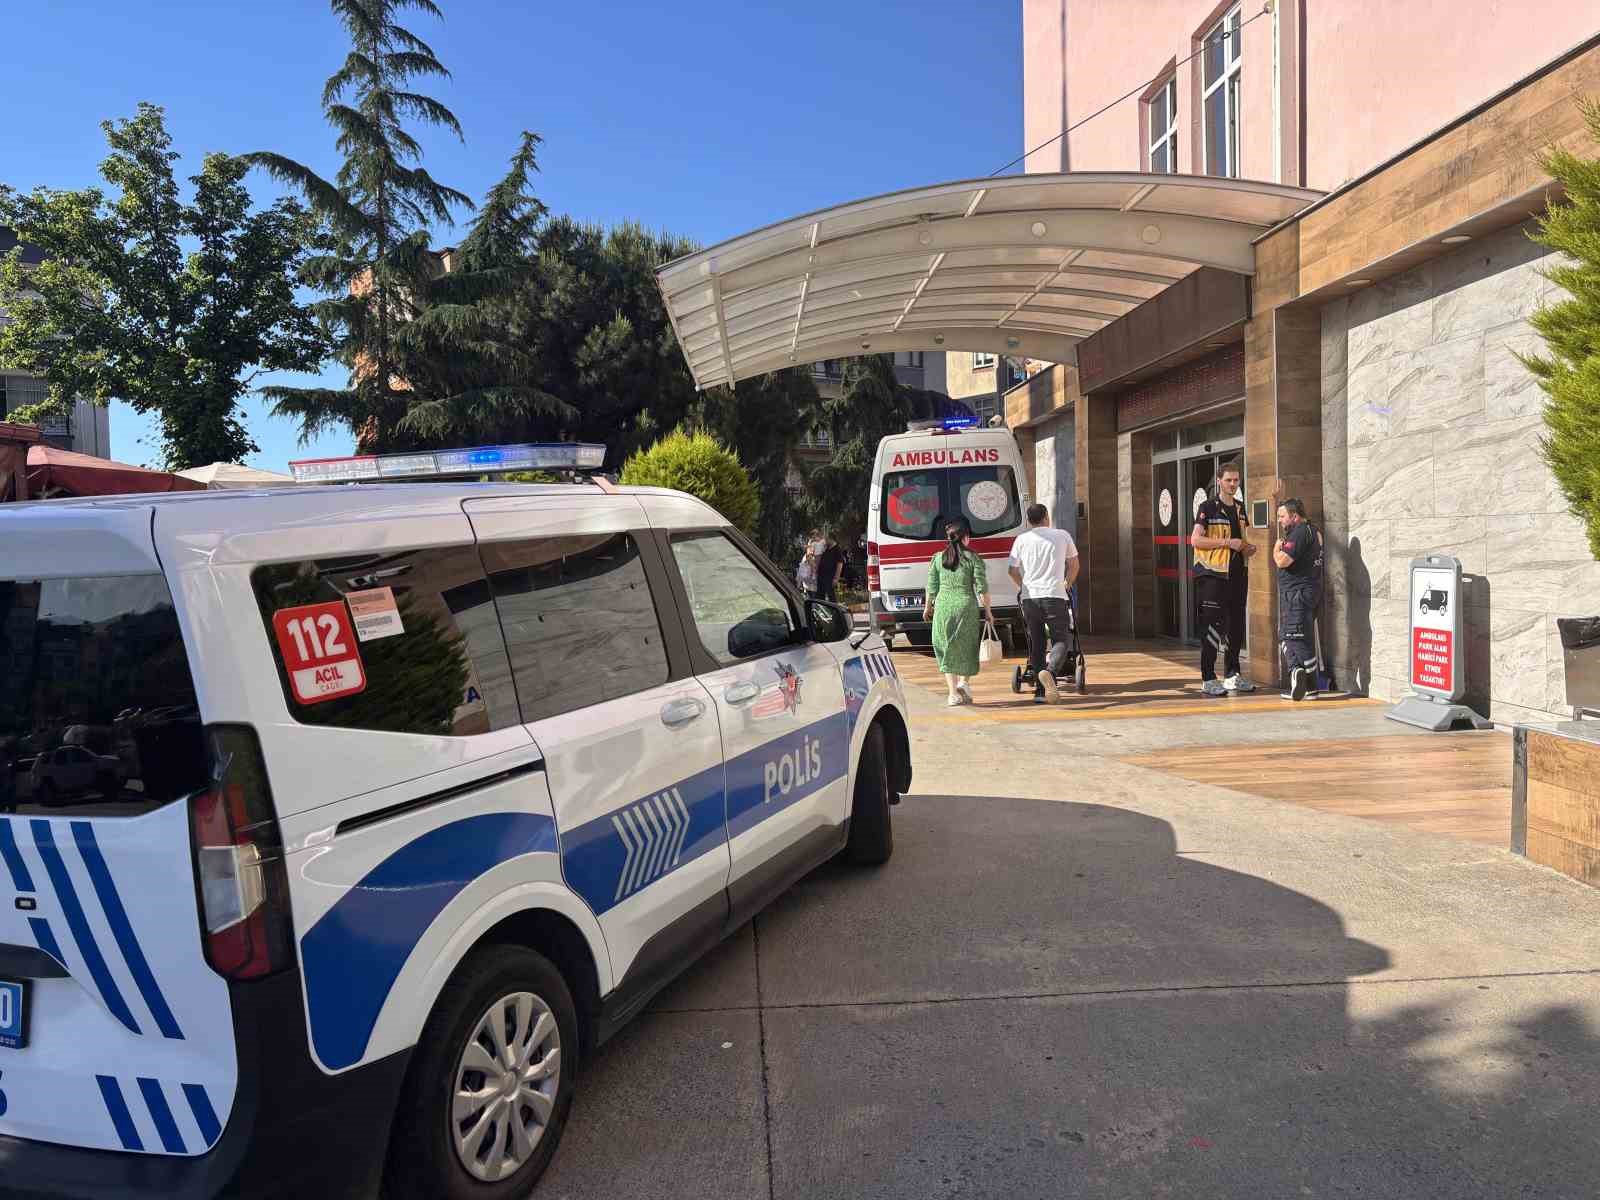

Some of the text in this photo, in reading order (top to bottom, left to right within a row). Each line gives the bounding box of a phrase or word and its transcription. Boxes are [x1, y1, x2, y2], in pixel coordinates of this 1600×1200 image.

[893, 448, 999, 466] AMBULANS
[286, 613, 347, 662] 112
[764, 735, 821, 804] POLİS
